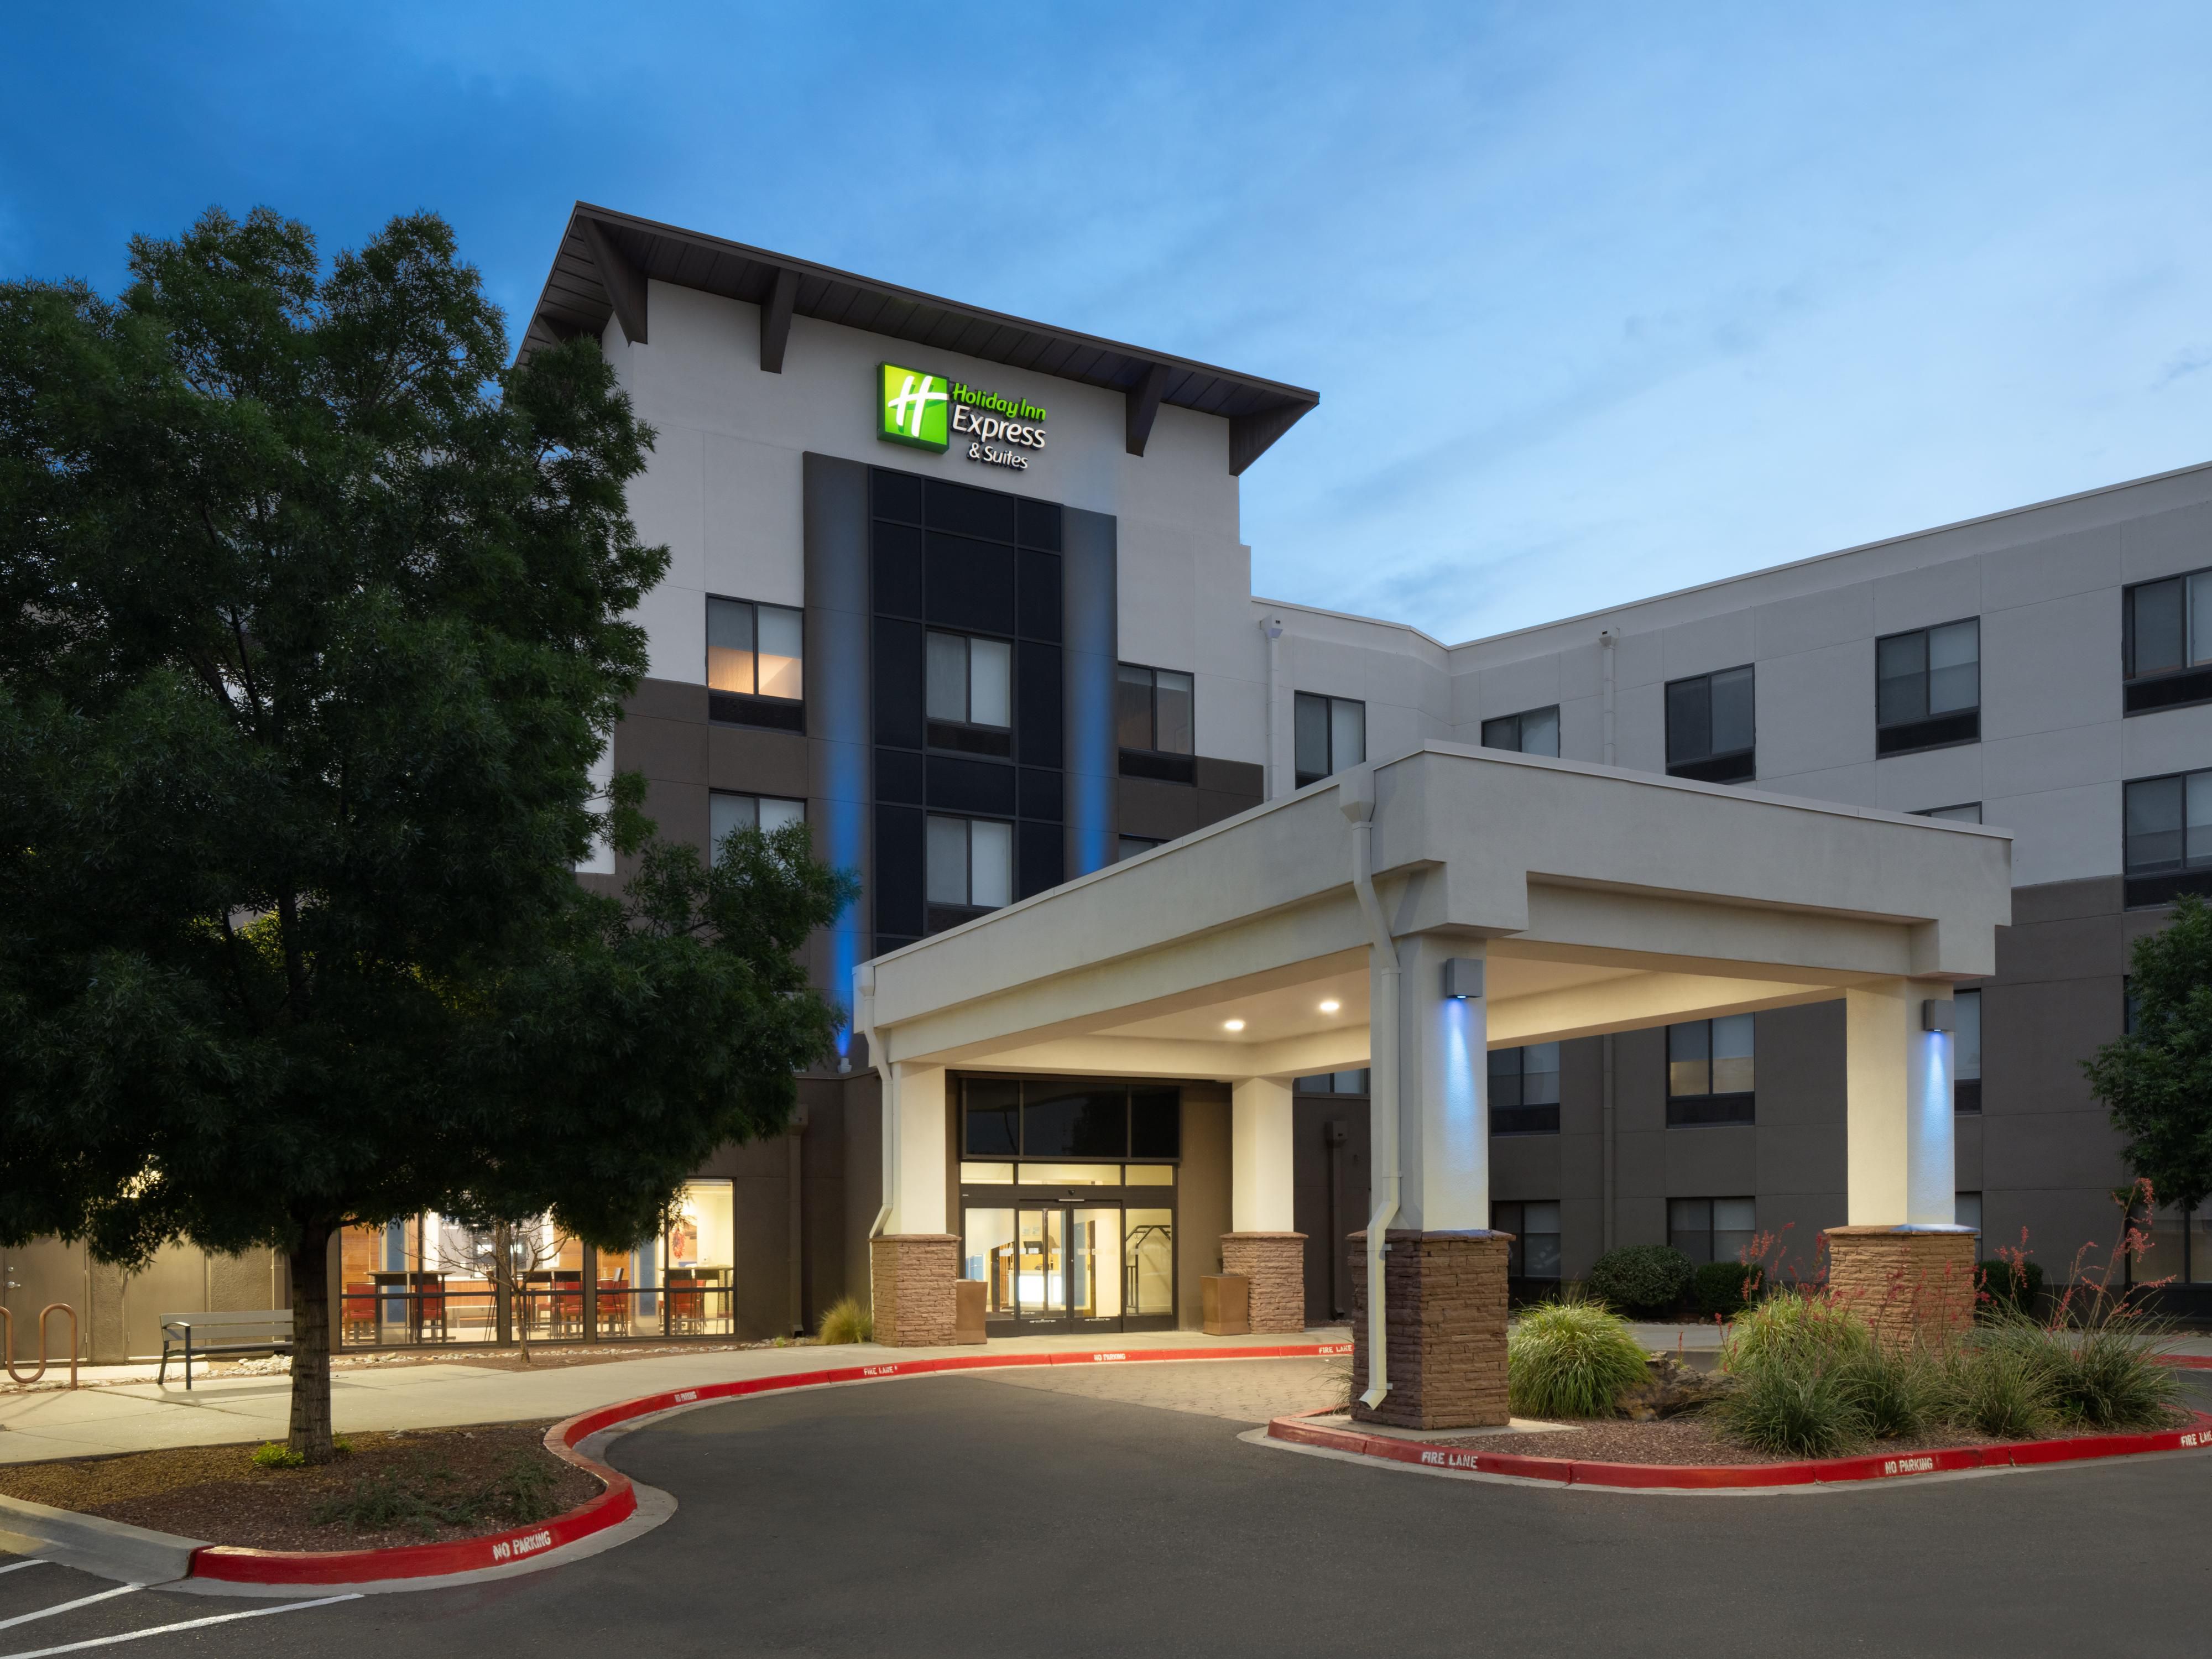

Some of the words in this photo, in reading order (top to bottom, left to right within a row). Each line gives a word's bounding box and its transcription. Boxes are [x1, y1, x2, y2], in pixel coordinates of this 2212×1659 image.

[952, 382, 1019, 418] Holiday
[1020, 398, 1046, 421] Inn
[952, 404, 1046, 448] Express
[969, 442, 980, 459] &
[983, 445, 1029, 469] Suites
[2181, 1433, 2197, 1447] FIRE
[1422, 1451, 1445, 1465] FIRE
[1449, 1454, 1478, 1469] LANE
[1885, 1461, 1897, 1474] NO
[1899, 1457, 1933, 1473] PARKING
[493, 1542, 510, 1561] NO
[513, 1531, 551, 1555] PARKING
